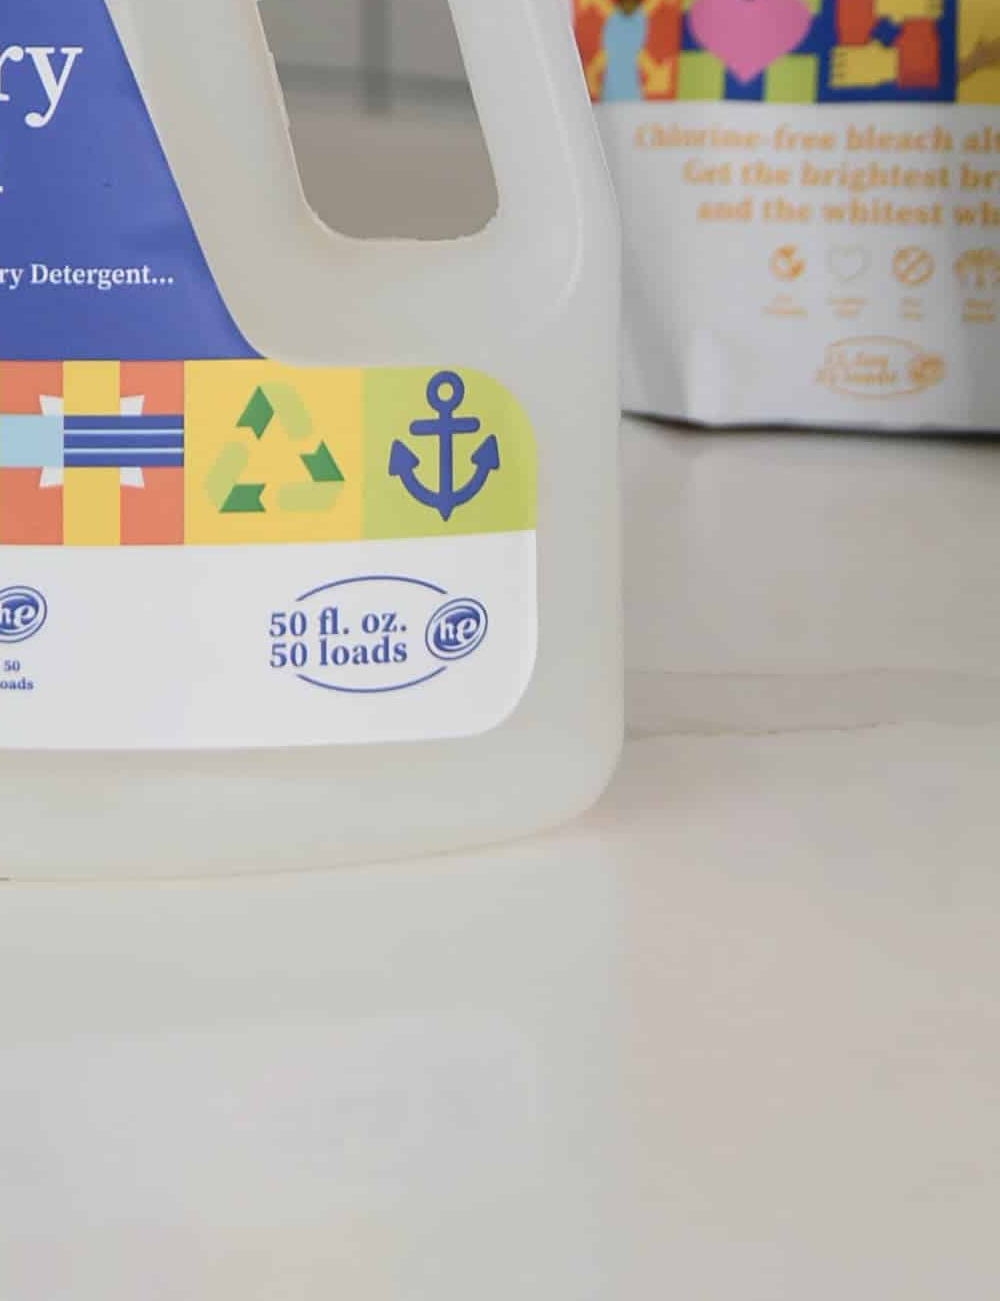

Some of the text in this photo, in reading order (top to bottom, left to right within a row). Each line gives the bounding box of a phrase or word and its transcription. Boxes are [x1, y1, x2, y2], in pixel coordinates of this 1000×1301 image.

[269, 606, 408, 637] 50 fl. oz.
[4, 660, 21, 673] 50
[269, 636, 408, 668] 50 loads
